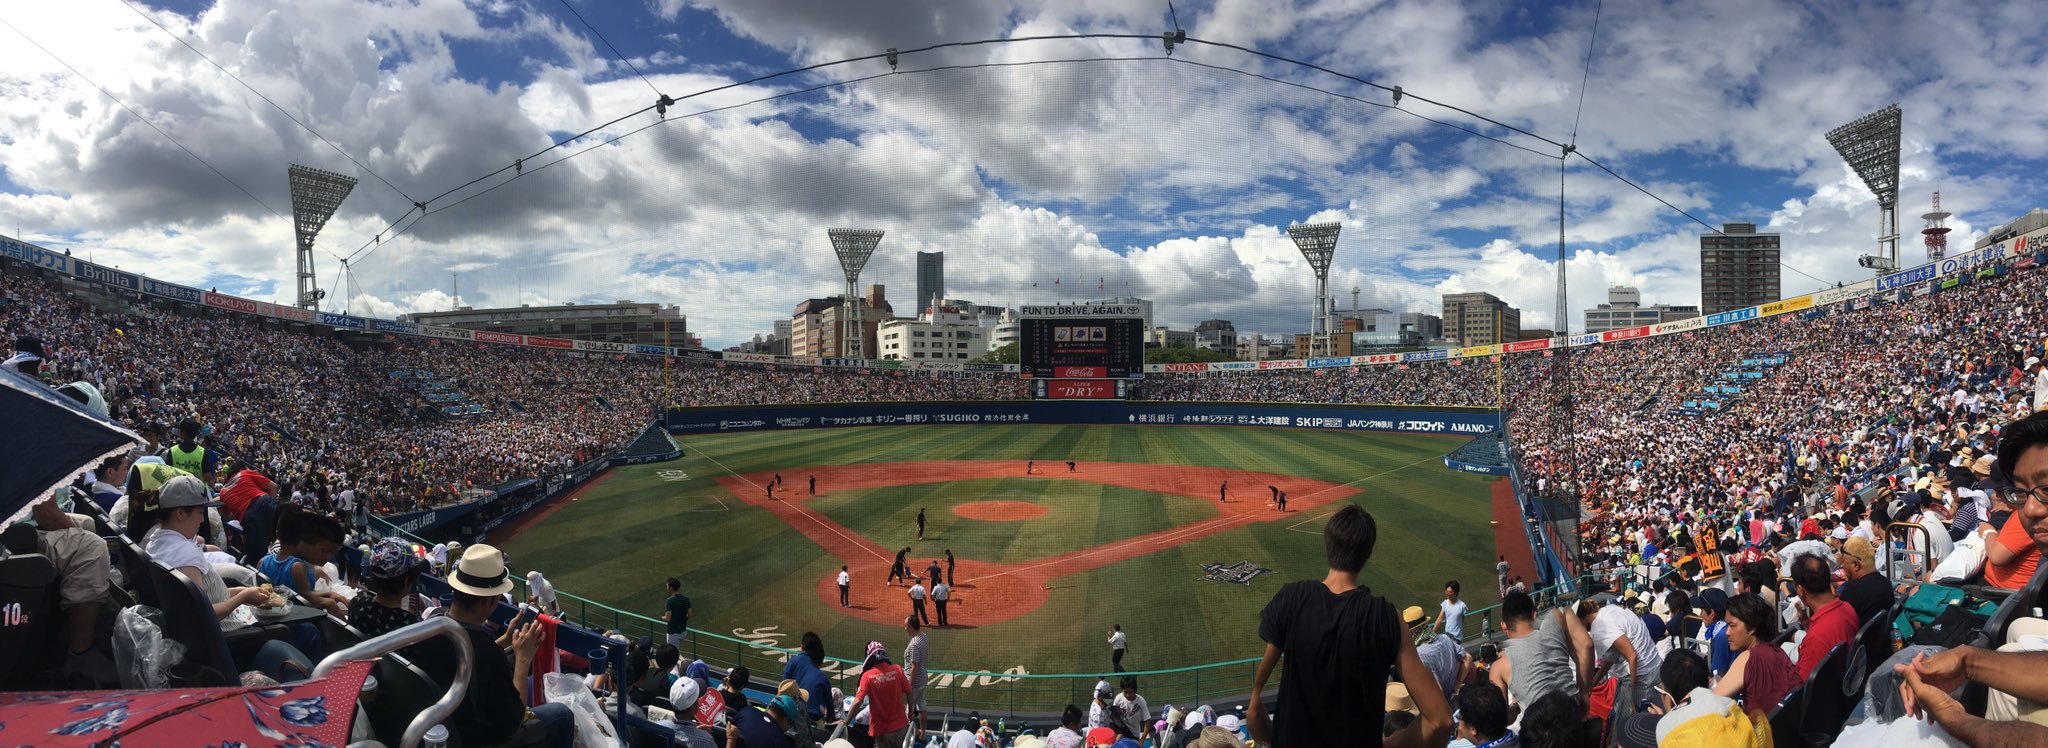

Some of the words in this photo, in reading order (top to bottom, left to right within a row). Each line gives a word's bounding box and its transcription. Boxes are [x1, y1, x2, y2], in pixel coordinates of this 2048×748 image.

[83, 264, 130, 287] Brillia
[1892, 267, 1934, 287] 神奈川大学
[207, 294, 256, 312] KOKUYO
[1022, 307, 1041, 315] FUN
[1044, 307, 1056, 315] TO
[1092, 307, 1126, 315] AGAIN.
[476, 332, 519, 343] POMPADOUR
[876, 414, 928, 423] キリン一番搾り
[940, 414, 980, 422] SUGIKO
[1139, 413, 1175, 423] 横浜銀行
[1257, 416, 1290, 425] 大洋建設
[1347, 419, 1393, 429] JAバンク神奈川
[1406, 420, 1445, 431] コロワイド
[1450, 422, 1485, 433] AMANO
[419, 512, 436, 528] LAGER
